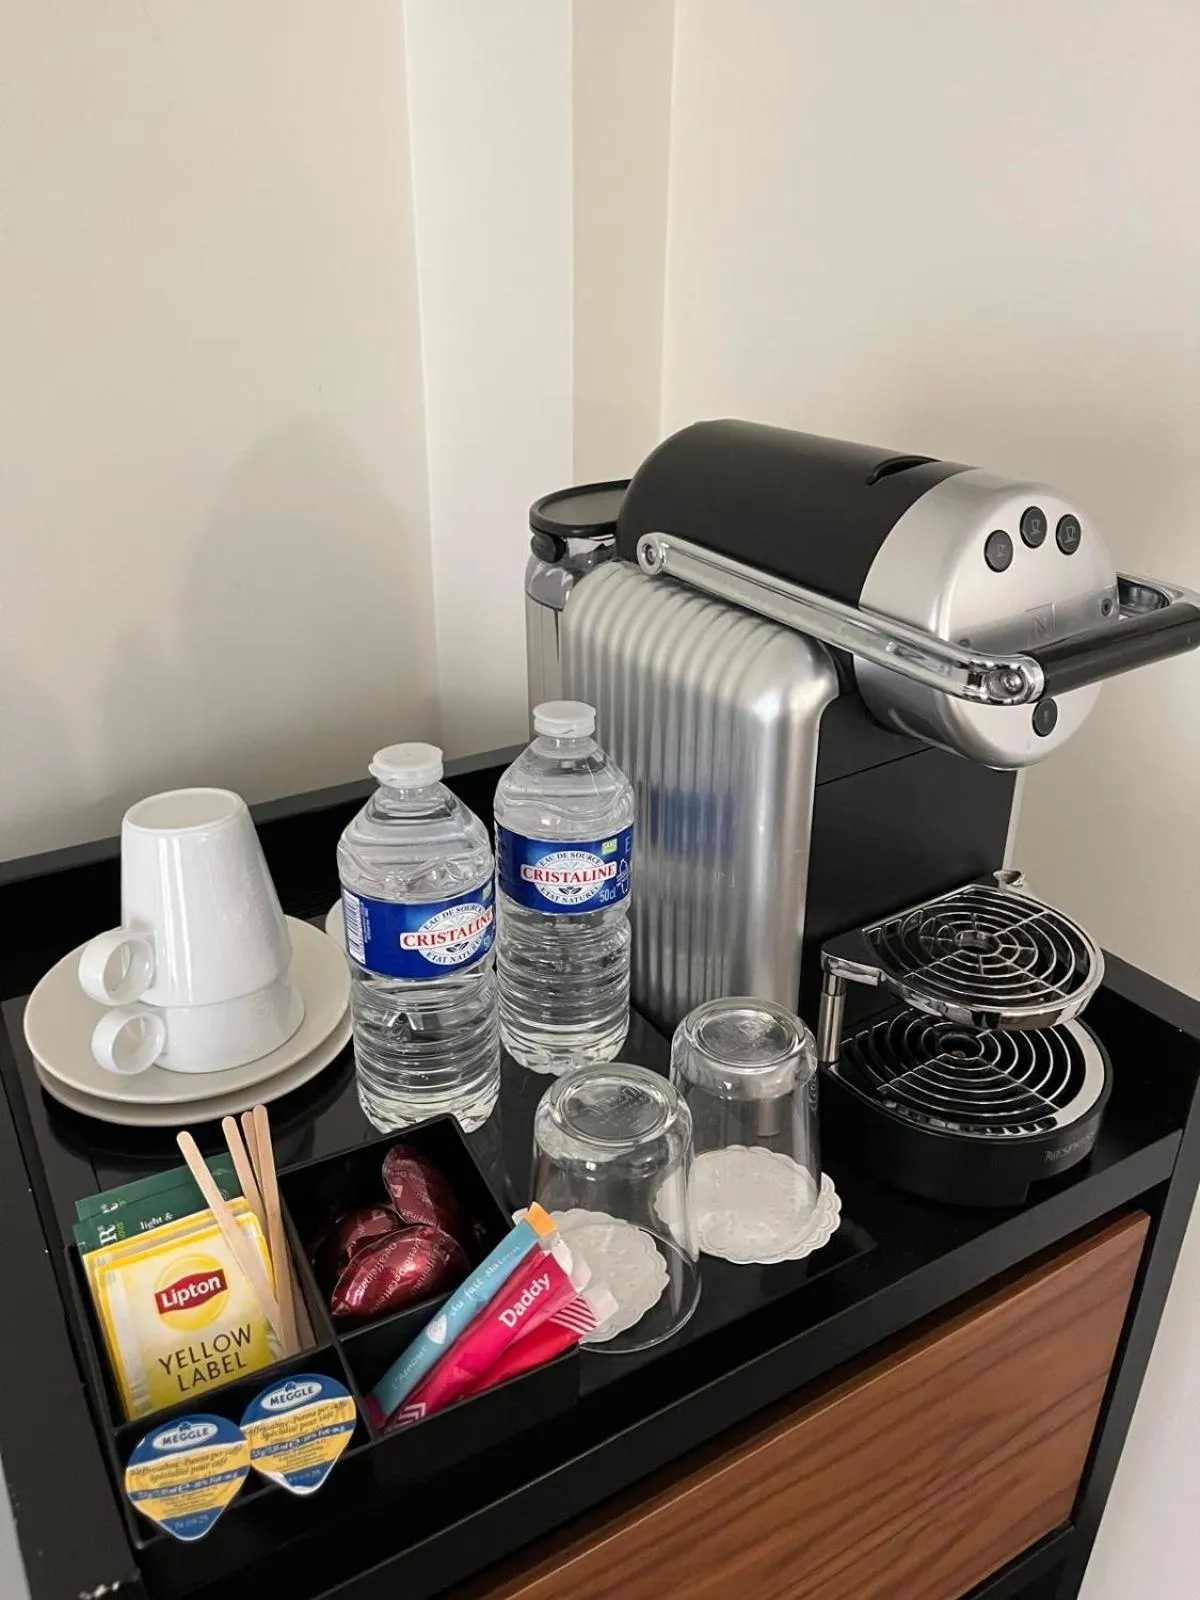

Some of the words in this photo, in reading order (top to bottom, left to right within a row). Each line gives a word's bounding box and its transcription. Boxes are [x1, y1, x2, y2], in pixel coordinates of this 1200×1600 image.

[540, 855, 554, 867] EAU
[570, 853, 601, 866] SOURCE
[522, 866, 616, 883] CRISTALINE
[600, 887, 617, 903] 50cl
[424, 916, 439, 930] EAU
[442, 910, 452, 918] DE
[162, 1275, 221, 1309] Lipton
[498, 1272, 551, 1328] Daddy
[158, 1324, 252, 1375] YELLOW
[178, 1351, 247, 1392] LABEL
[270, 1386, 313, 1406] MEGGLE
[162, 1428, 209, 1446] MEGGLE
